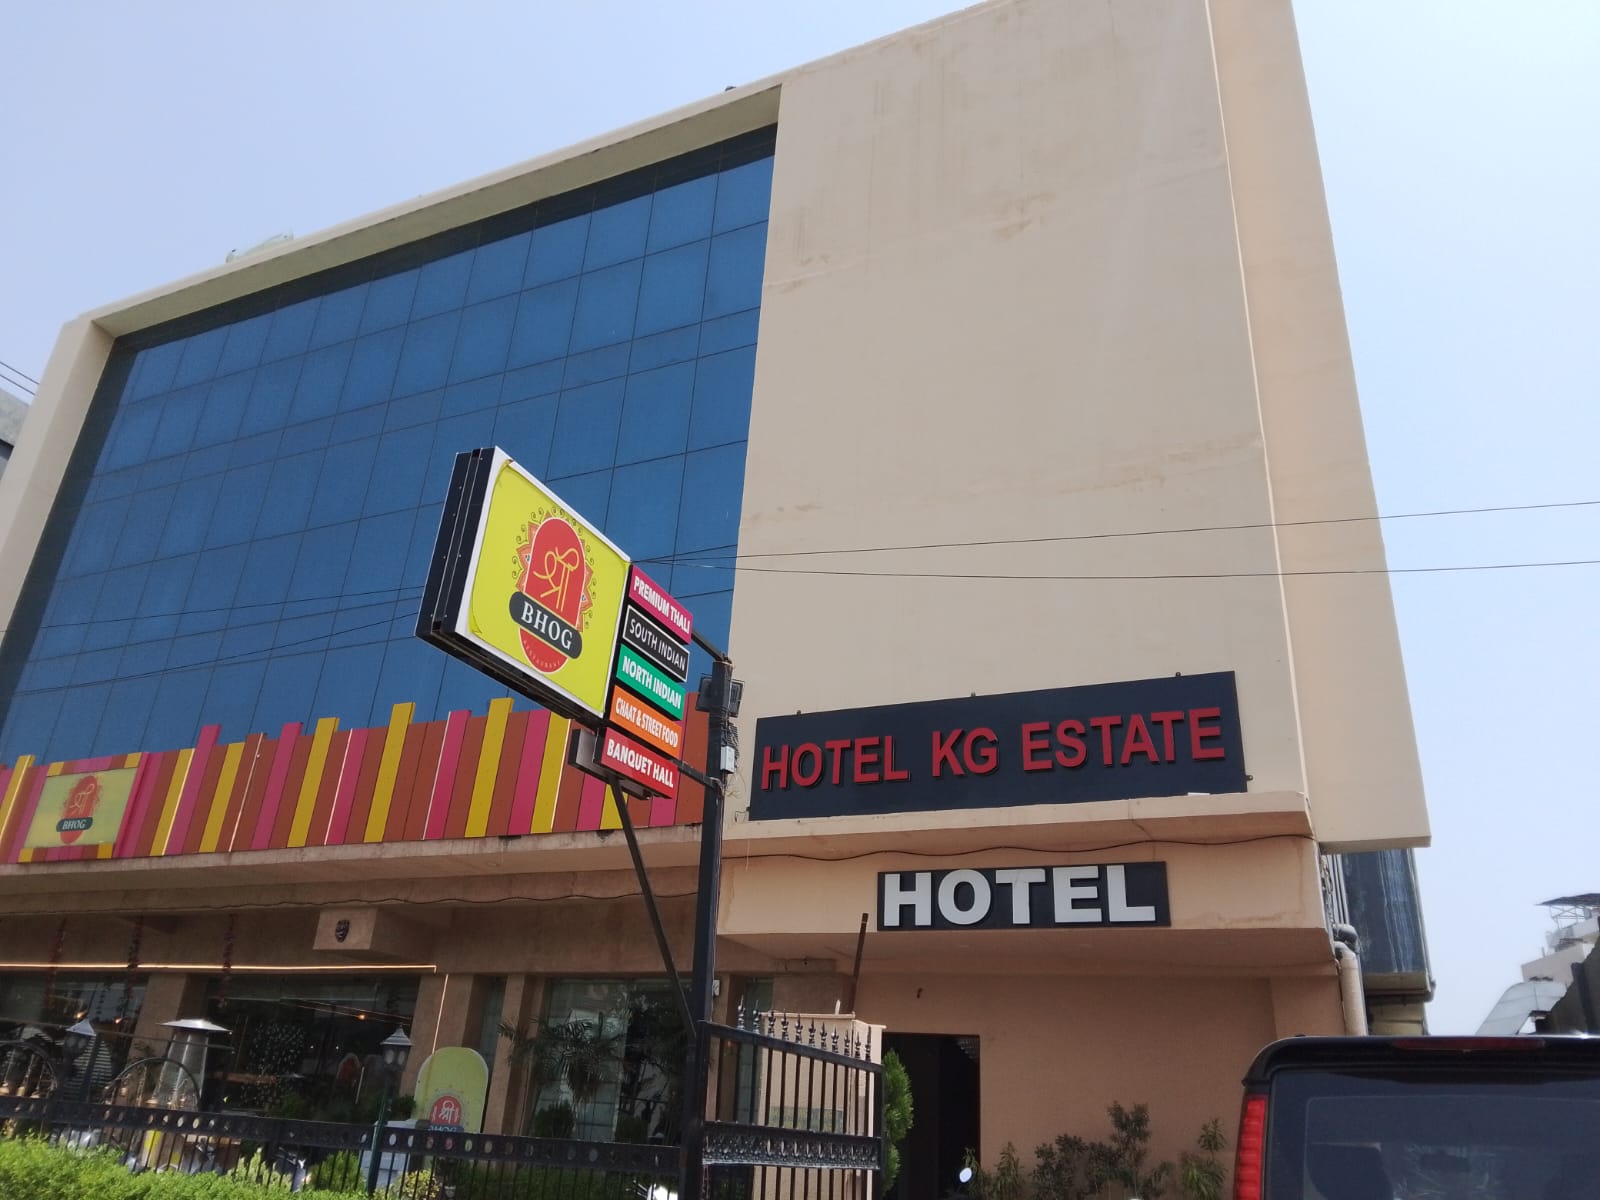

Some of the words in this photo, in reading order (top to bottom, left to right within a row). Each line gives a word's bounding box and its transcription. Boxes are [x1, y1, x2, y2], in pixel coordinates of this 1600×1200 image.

[521, 601, 573, 650] BHOG
[633, 575, 670, 617] PREMIUM
[670, 605, 691, 634] THALI
[630, 618, 658, 648] SOUTH
[658, 639, 686, 671] INDIAN
[622, 655, 653, 690] NORTH
[653, 677, 682, 710] INDIAN
[615, 697, 637, 723] CHAAT
[636, 709, 642, 727] &
[641, 712, 663, 738] STREET
[661, 724, 679, 748] FOOD
[761, 735, 910, 790] HOTEL
[931, 727, 999, 777] KG
[1021, 707, 1226, 771] ESTATE
[606, 738, 653, 776] BANQUET
[652, 763, 674, 789] HALL
[883, 864, 1156, 927] HOTEL
